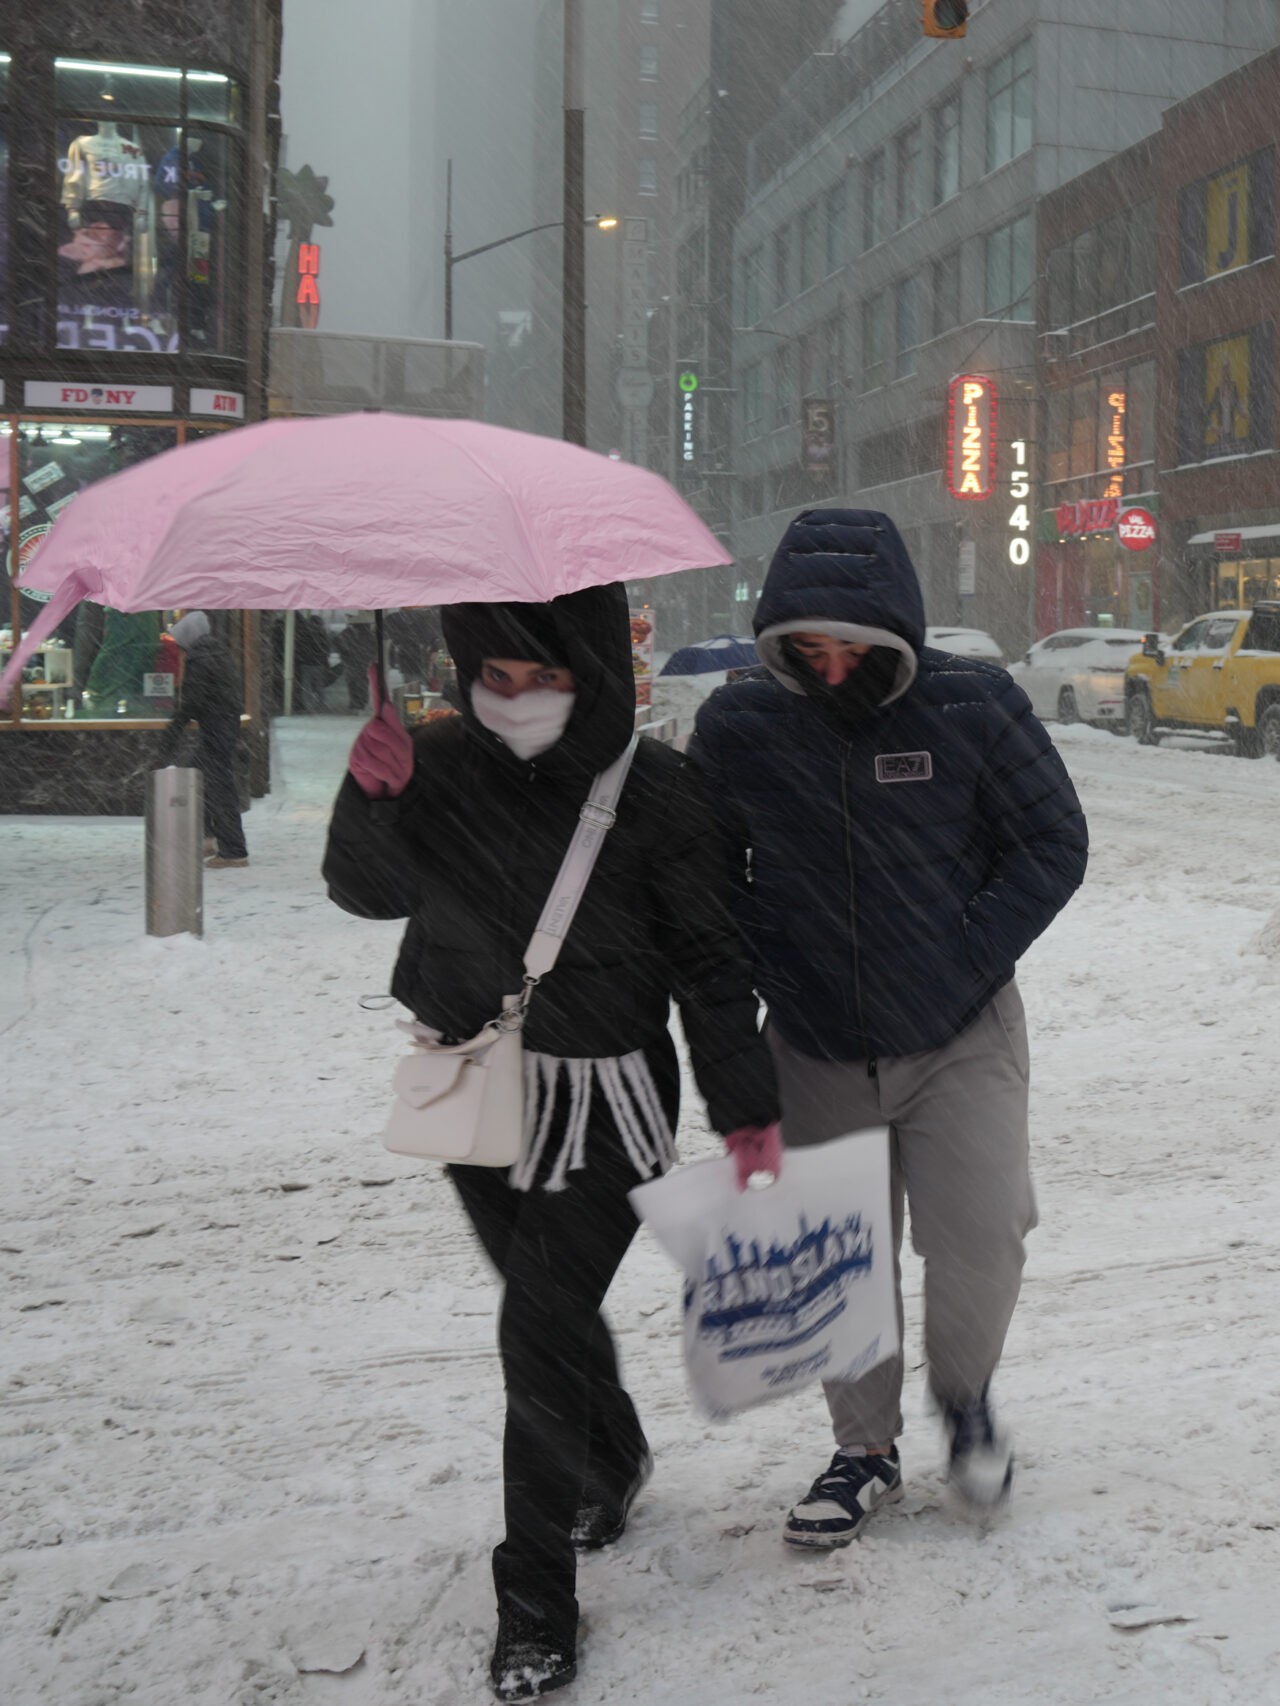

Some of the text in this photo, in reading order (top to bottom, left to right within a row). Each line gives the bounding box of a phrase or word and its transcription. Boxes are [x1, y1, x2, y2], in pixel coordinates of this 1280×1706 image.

[213, 394, 237, 413] ATM
[683, 392, 695, 461] PARKING
[960, 382, 984, 494] PIZZA
[1008, 438, 1031, 566] 1540
[1118, 523, 1156, 540] PIZZA
[884, 756, 921, 773] EA7
